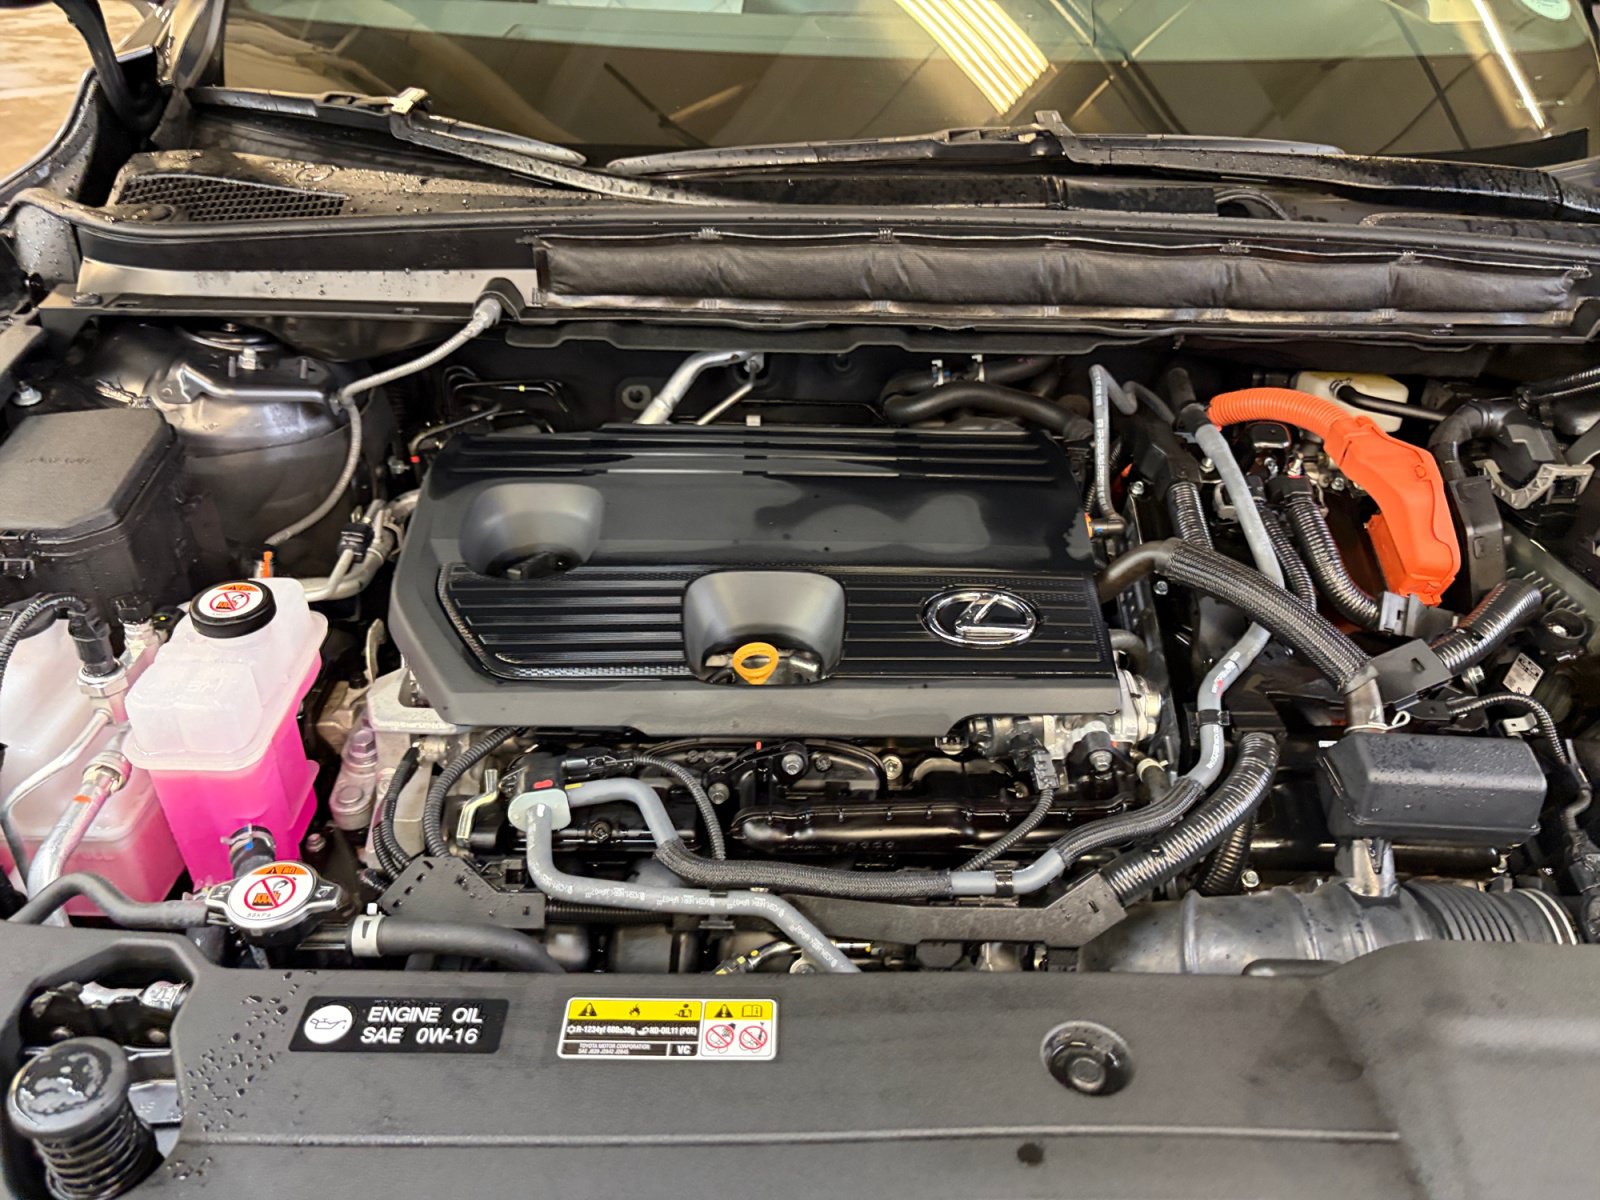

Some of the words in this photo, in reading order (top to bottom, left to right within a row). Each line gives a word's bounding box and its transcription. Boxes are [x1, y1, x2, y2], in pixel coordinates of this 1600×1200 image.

[367, 1006, 442, 1023] ENGINE
[451, 1007, 483, 1024] OIL
[360, 1026, 404, 1044] SAE
[415, 1027, 479, 1044] 0W-16
[676, 1045, 692, 1055] VC
